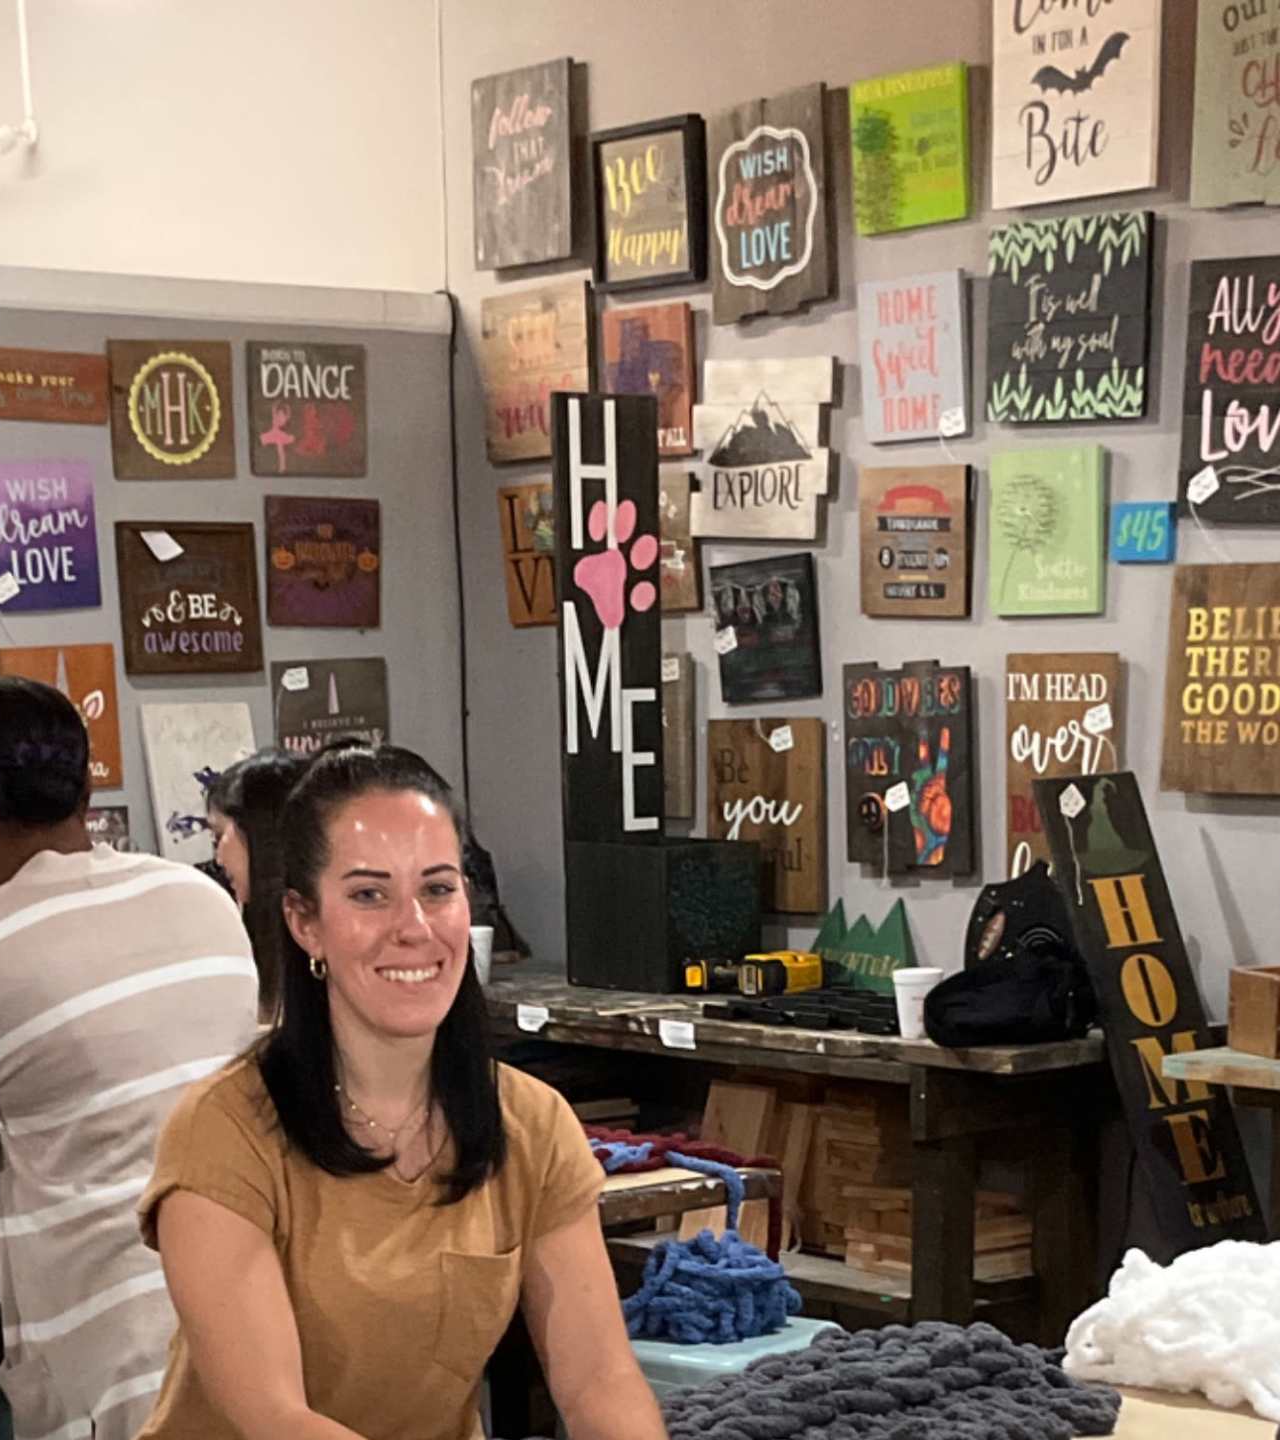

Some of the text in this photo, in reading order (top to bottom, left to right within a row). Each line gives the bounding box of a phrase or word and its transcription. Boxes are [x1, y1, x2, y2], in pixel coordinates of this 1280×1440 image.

[1019, 101, 1110, 186] Bite
[606, 144, 663, 216] Bee
[739, 147, 788, 180] WISH
[740, 222, 791, 268] LOVE
[1207, 275, 1265, 335] All
[40, 375, 75, 389] your
[260, 363, 354, 399] DANCE
[6, 478, 68, 501] WISH
[713, 464, 805, 510] EXPLORE
[1117, 510, 1168, 551] $45
[10, 546, 76, 585] LOVE
[188, 593, 218, 619] BE
[144, 630, 245, 655] awesome
[1008, 673, 1108, 701] I'M HEAD
[1181, 720, 1229, 744] THE
[724, 795, 802, 840] you
